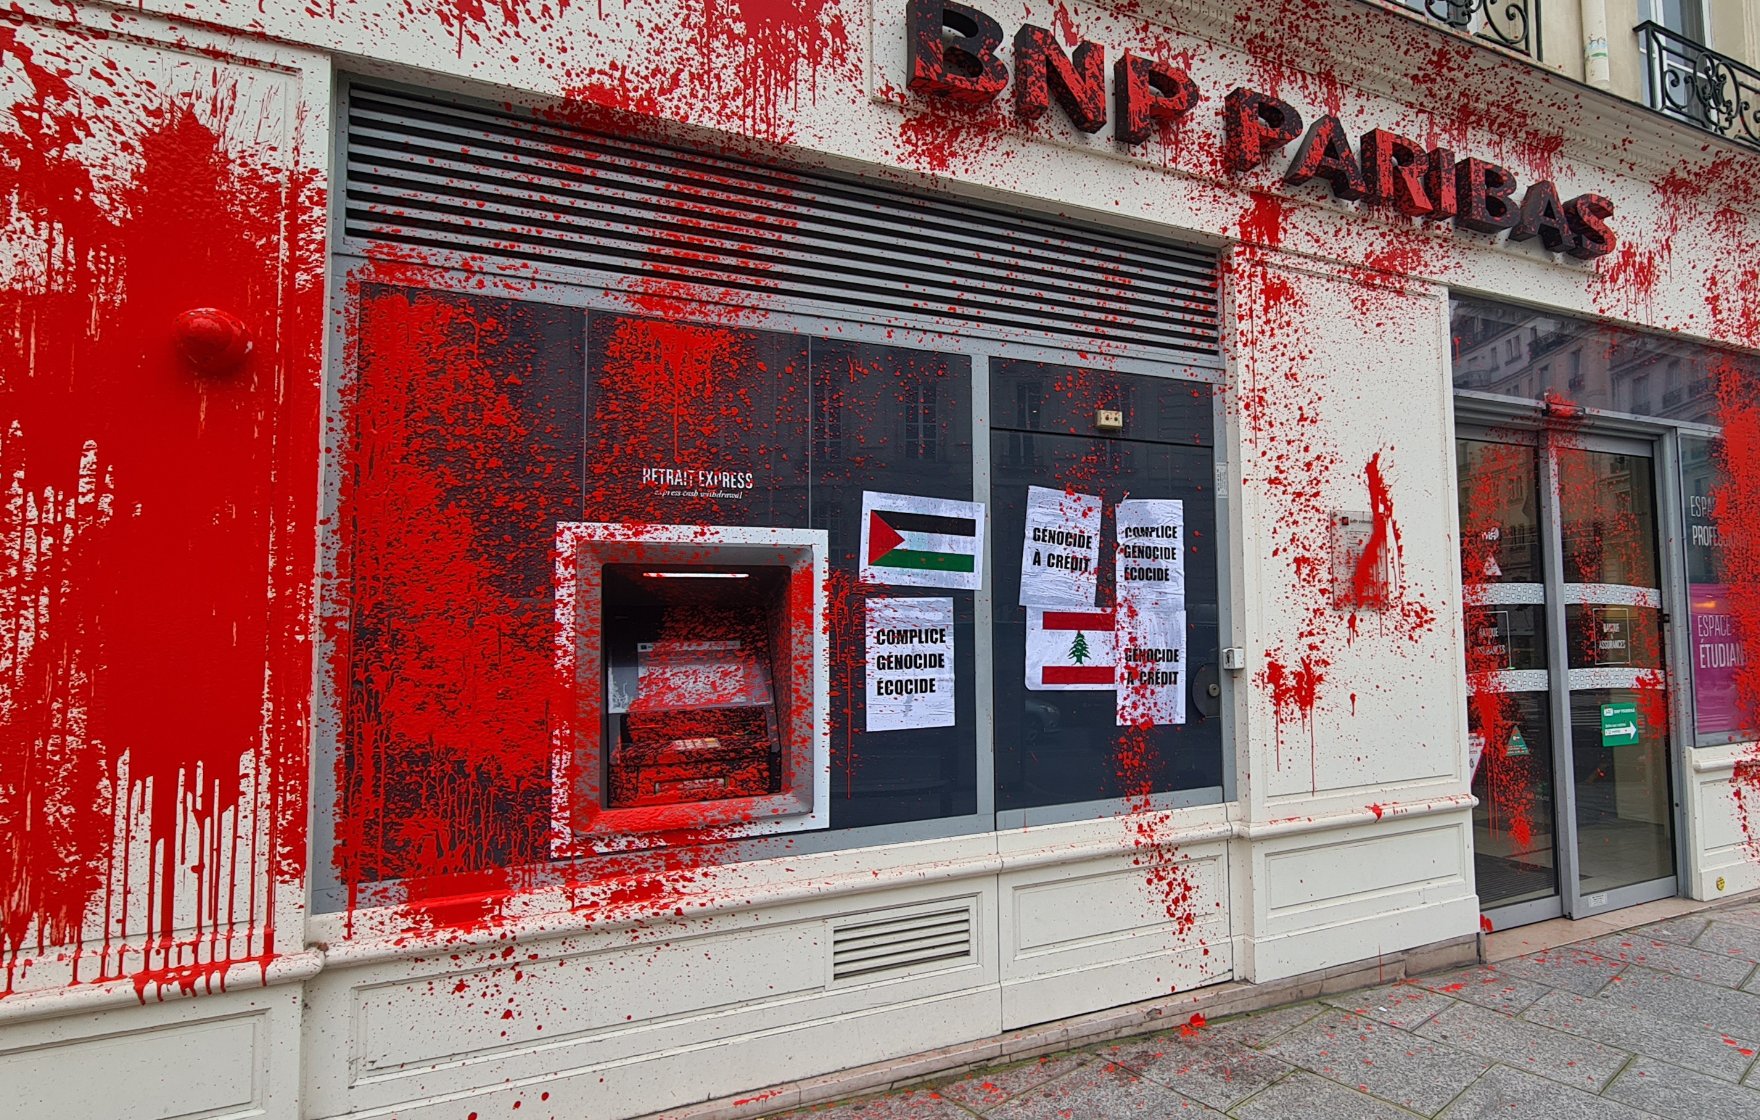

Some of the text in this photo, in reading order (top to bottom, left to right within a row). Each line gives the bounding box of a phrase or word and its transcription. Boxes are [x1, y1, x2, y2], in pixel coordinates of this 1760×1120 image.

[906, 0, 1616, 261] BNP PARIBAS
[642, 467, 754, 489] RETRAIT EXPRESS
[654, 490, 681, 498] epress
[1032, 526, 1093, 549] GÉNOCIDE
[1124, 525, 1178, 539] COMPLICE
[1032, 548, 1091, 573] À CRÉDIT
[1123, 543, 1177, 561] GÉNOCIDE
[1124, 565, 1170, 582] ÉCOCIDE
[1698, 615, 1732, 638] ESPACE
[876, 628, 946, 645] COMPLICE
[876, 652, 945, 671] GÉNOCIDE
[1140, 668, 1179, 685] CRÉDIT
[877, 678, 936, 697] ÉCOCIDE
